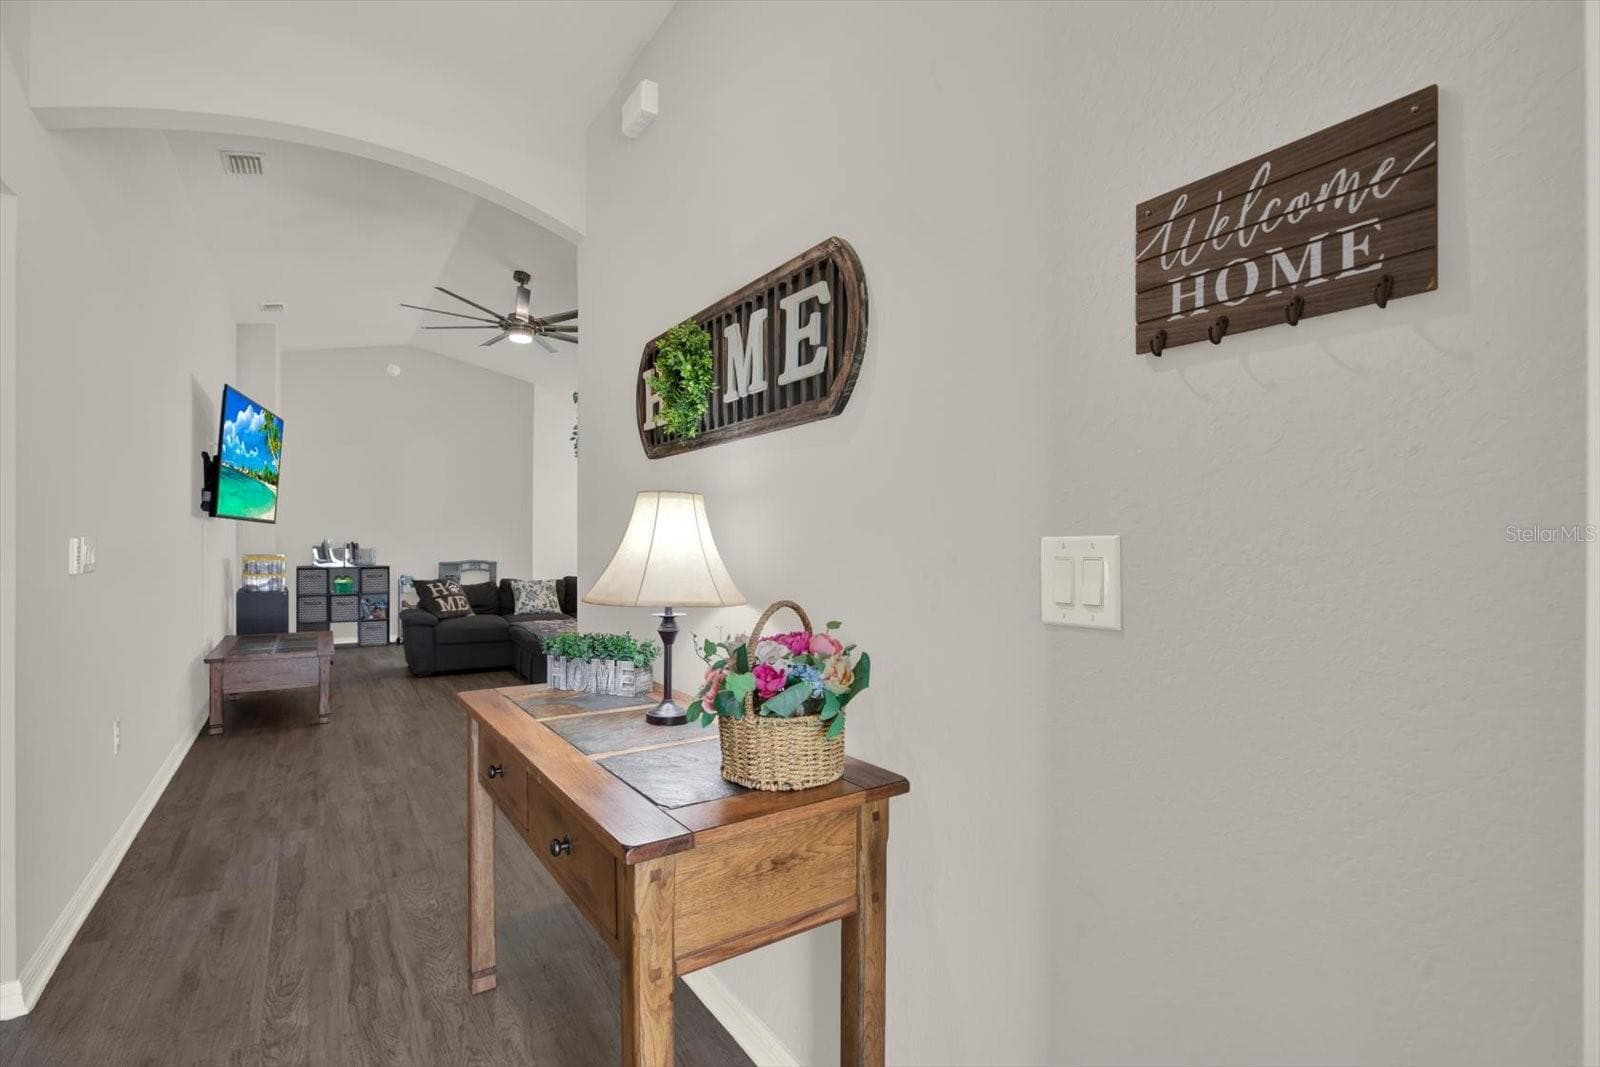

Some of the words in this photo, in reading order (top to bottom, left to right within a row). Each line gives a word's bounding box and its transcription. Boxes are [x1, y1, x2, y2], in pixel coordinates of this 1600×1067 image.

[1137, 140, 1436, 270] Welcome
[1167, 218, 1384, 321] HOME
[642, 280, 831, 431] HME
[547, 655, 635, 697] HOME
